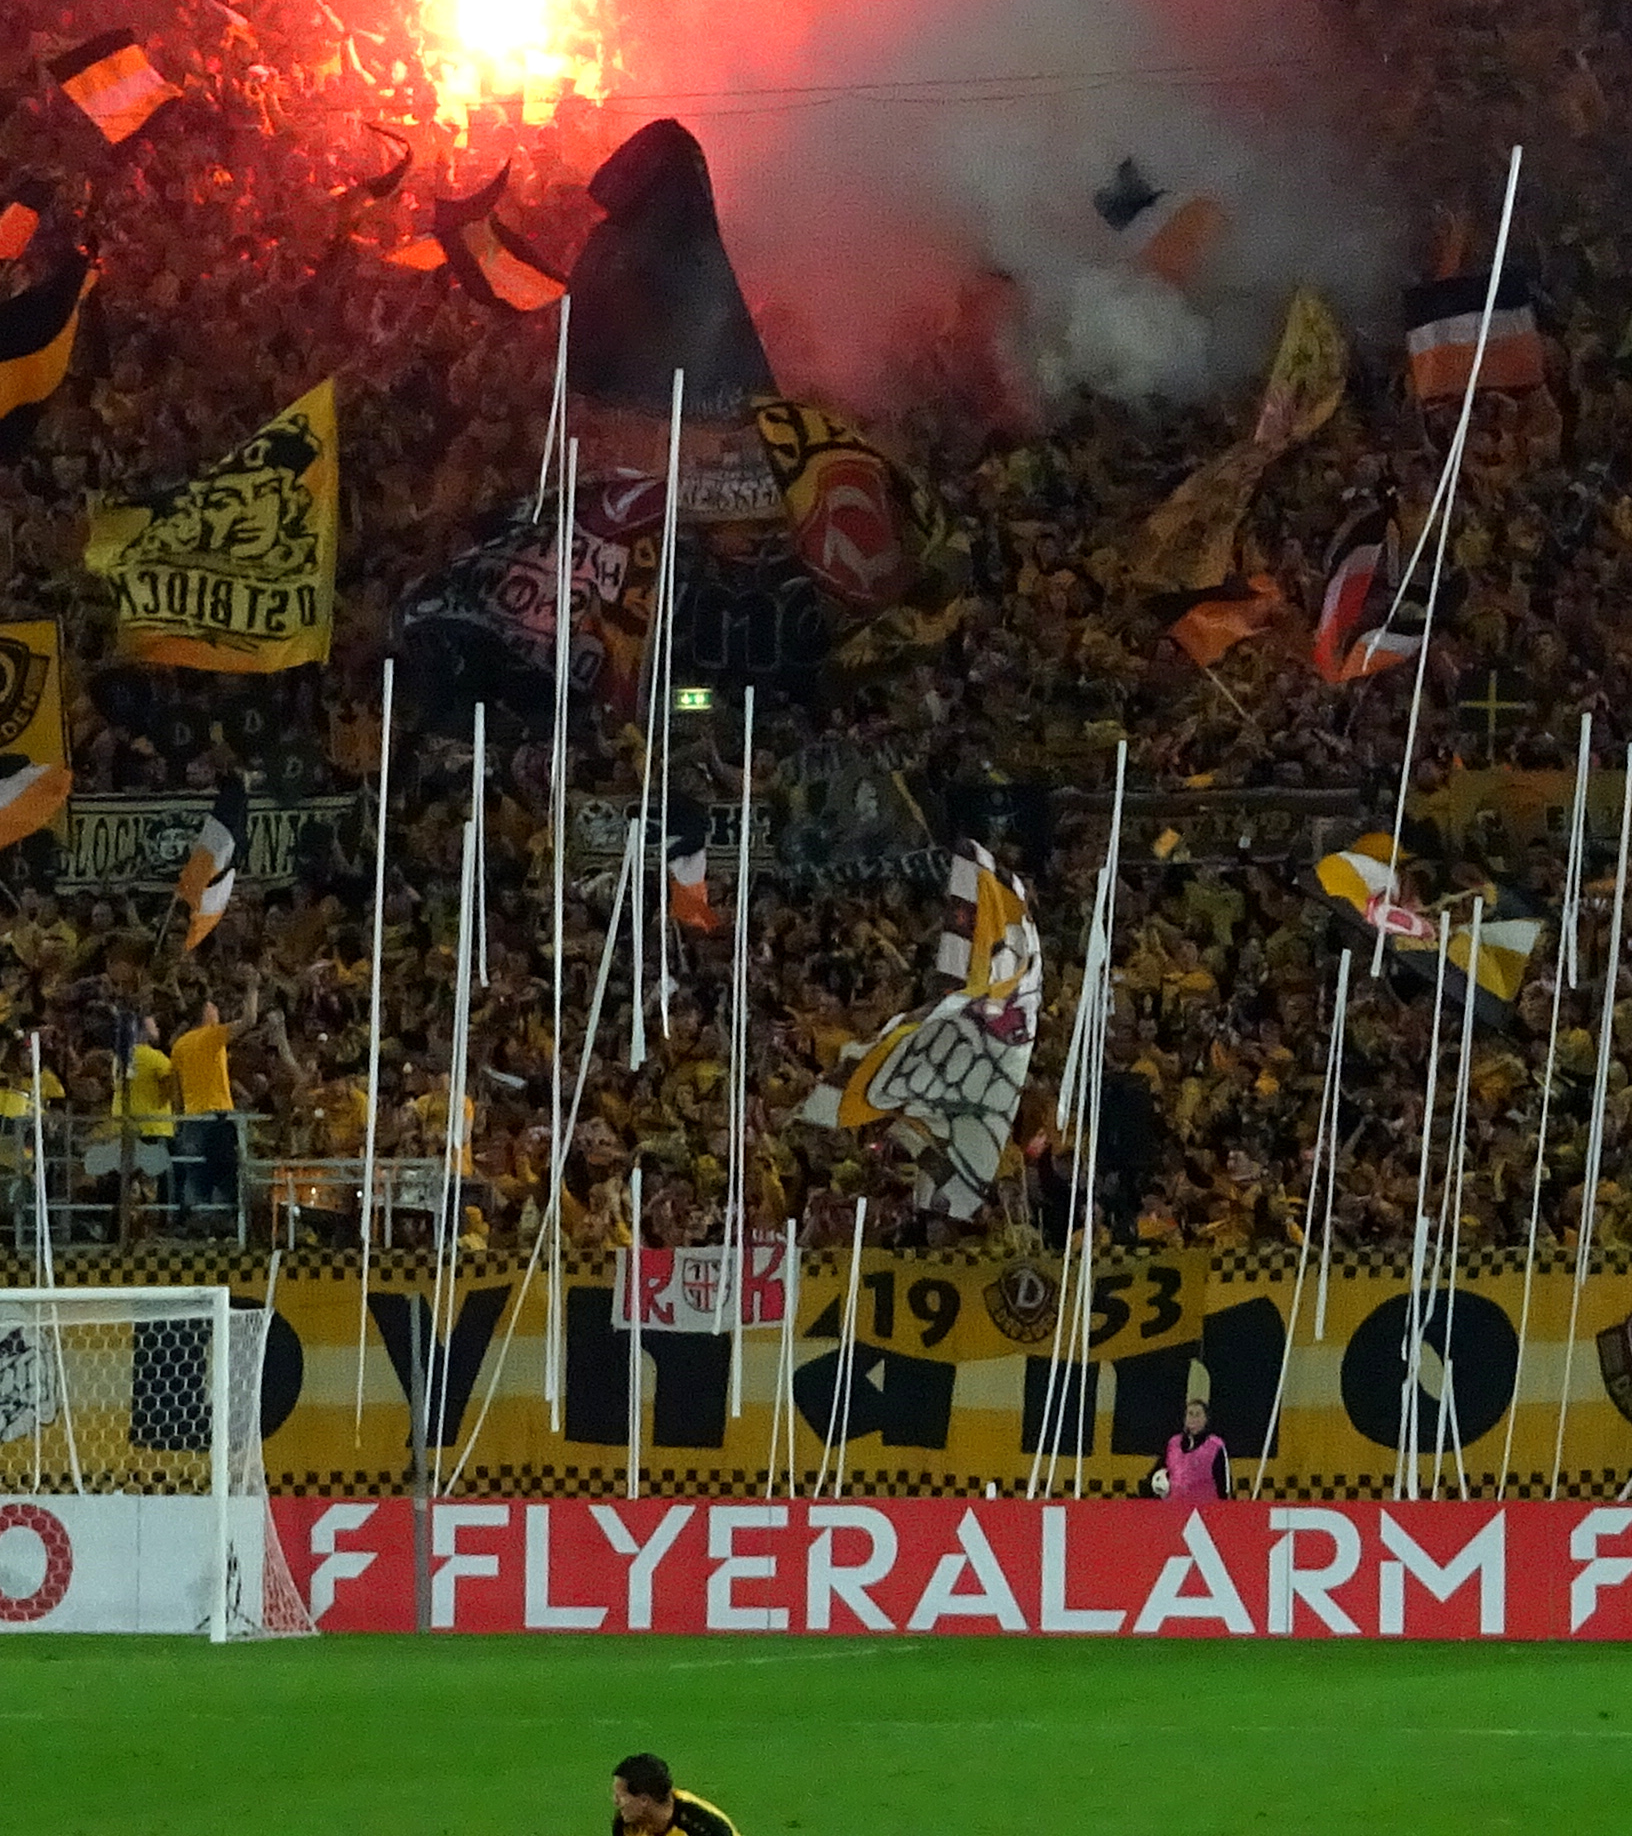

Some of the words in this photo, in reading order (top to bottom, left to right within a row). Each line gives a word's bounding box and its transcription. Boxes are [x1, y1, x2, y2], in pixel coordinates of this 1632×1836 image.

[862, 1269, 963, 1346] 19
[1088, 1266, 1184, 1343] 53
[431, 1503, 1506, 1635] FLYERALARM
